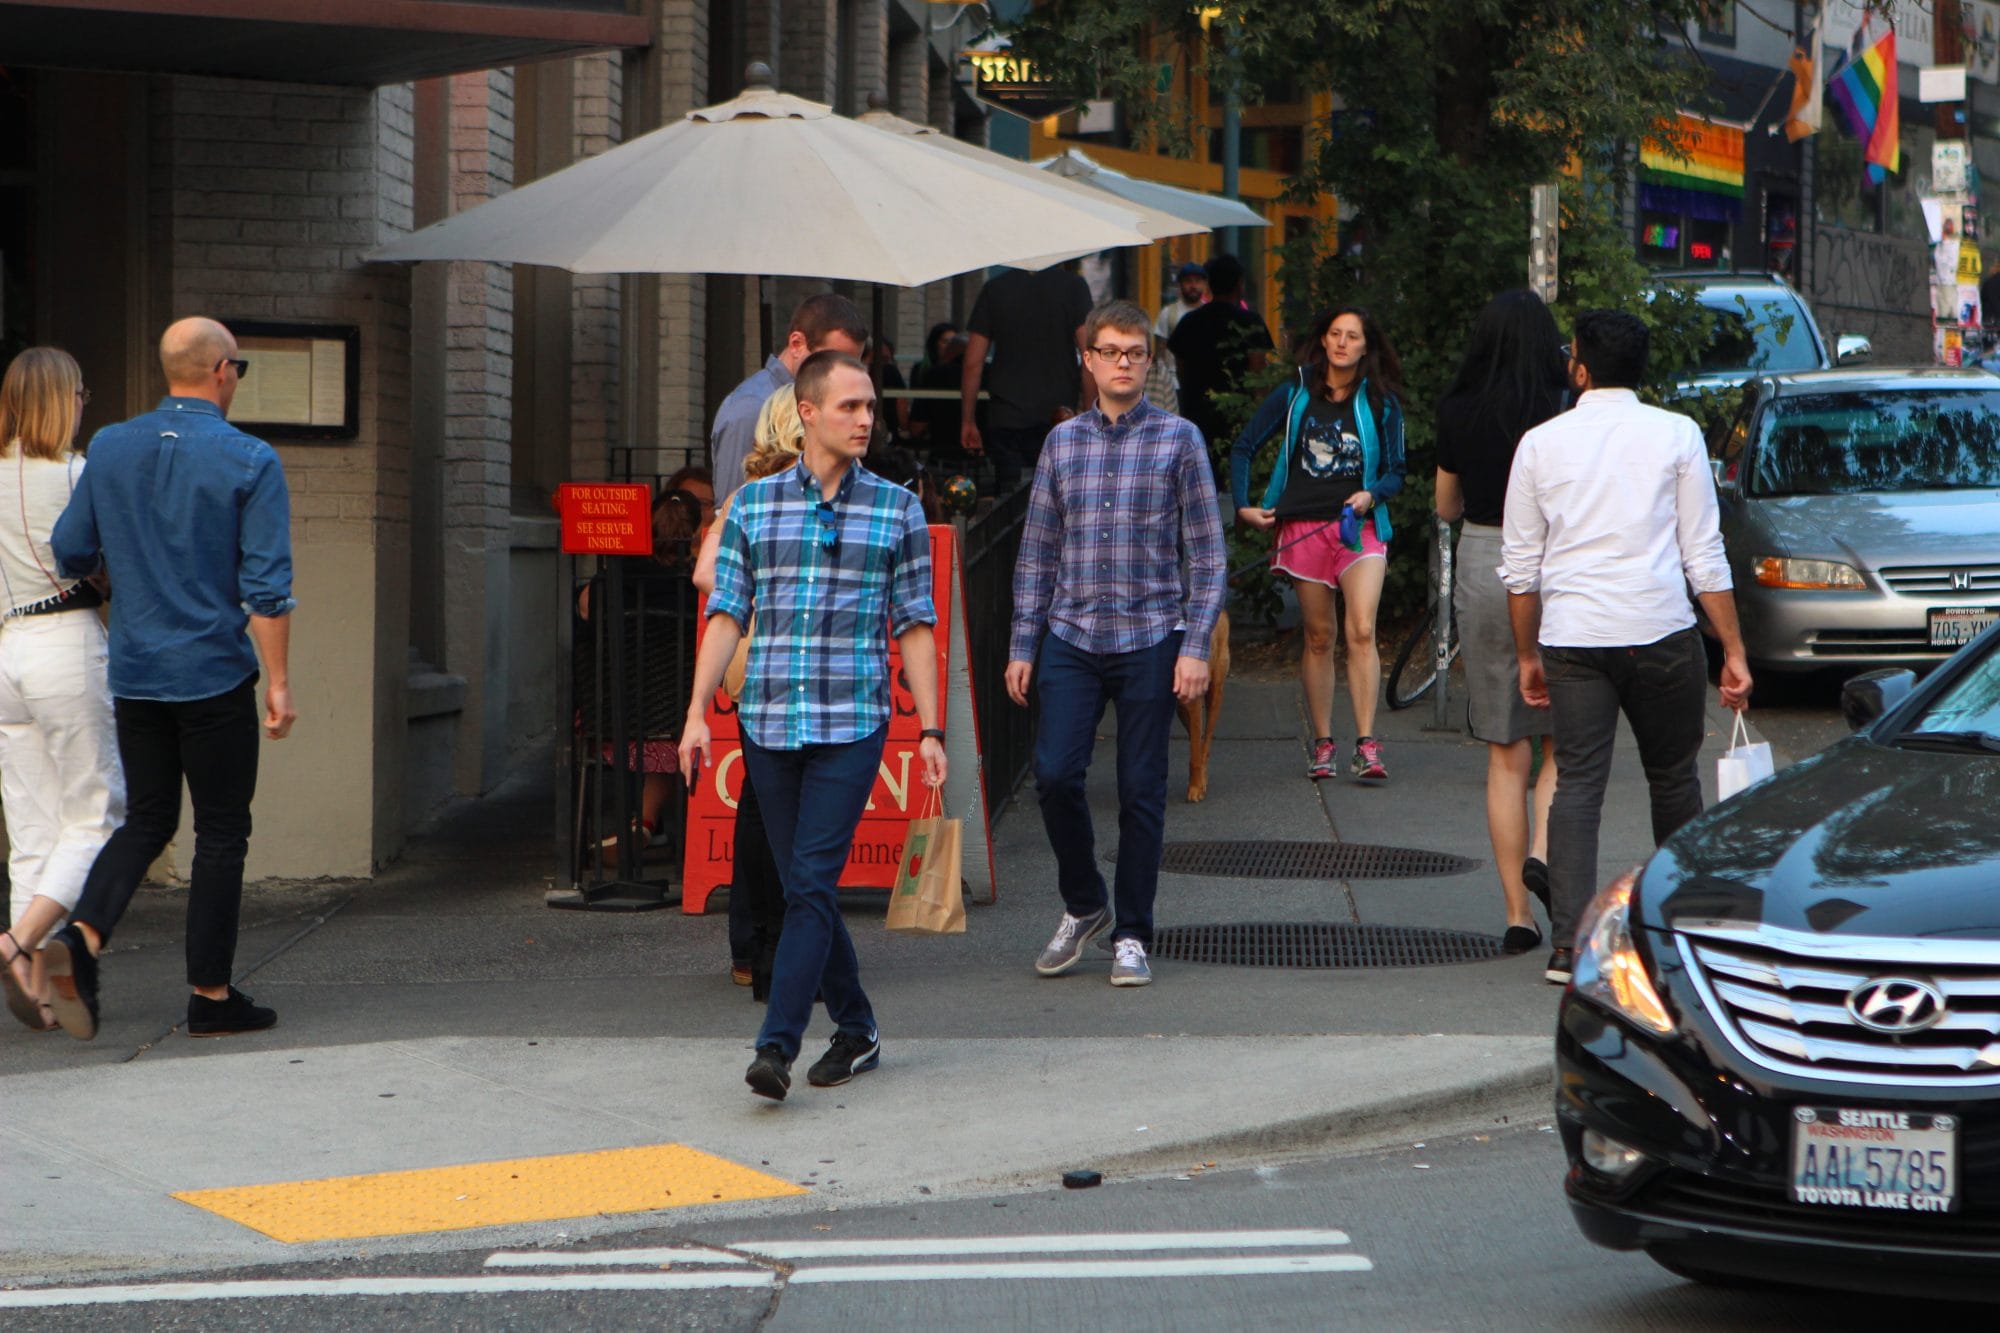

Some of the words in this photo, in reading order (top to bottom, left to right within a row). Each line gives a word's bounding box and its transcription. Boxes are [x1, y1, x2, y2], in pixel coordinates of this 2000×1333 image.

[572, 487, 591, 500] FOR
[593, 488, 638, 501] OUTSIDE
[582, 502, 629, 515] SEATING.
[577, 521, 594, 534] SEE
[596, 522, 634, 535] SERVER
[588, 536, 624, 549] INSIDE.
[850, 835, 905, 865] inne
[1838, 1109, 1910, 1130] SEATTLE
[1807, 1124, 1896, 1141] WASHINGTON
[1803, 1143, 1947, 1194] AAL5785
[1795, 1185, 1863, 1206] TOYOTA
[1864, 1190, 1910, 1210] LAKE
[1911, 1194, 1951, 1213] CITY
